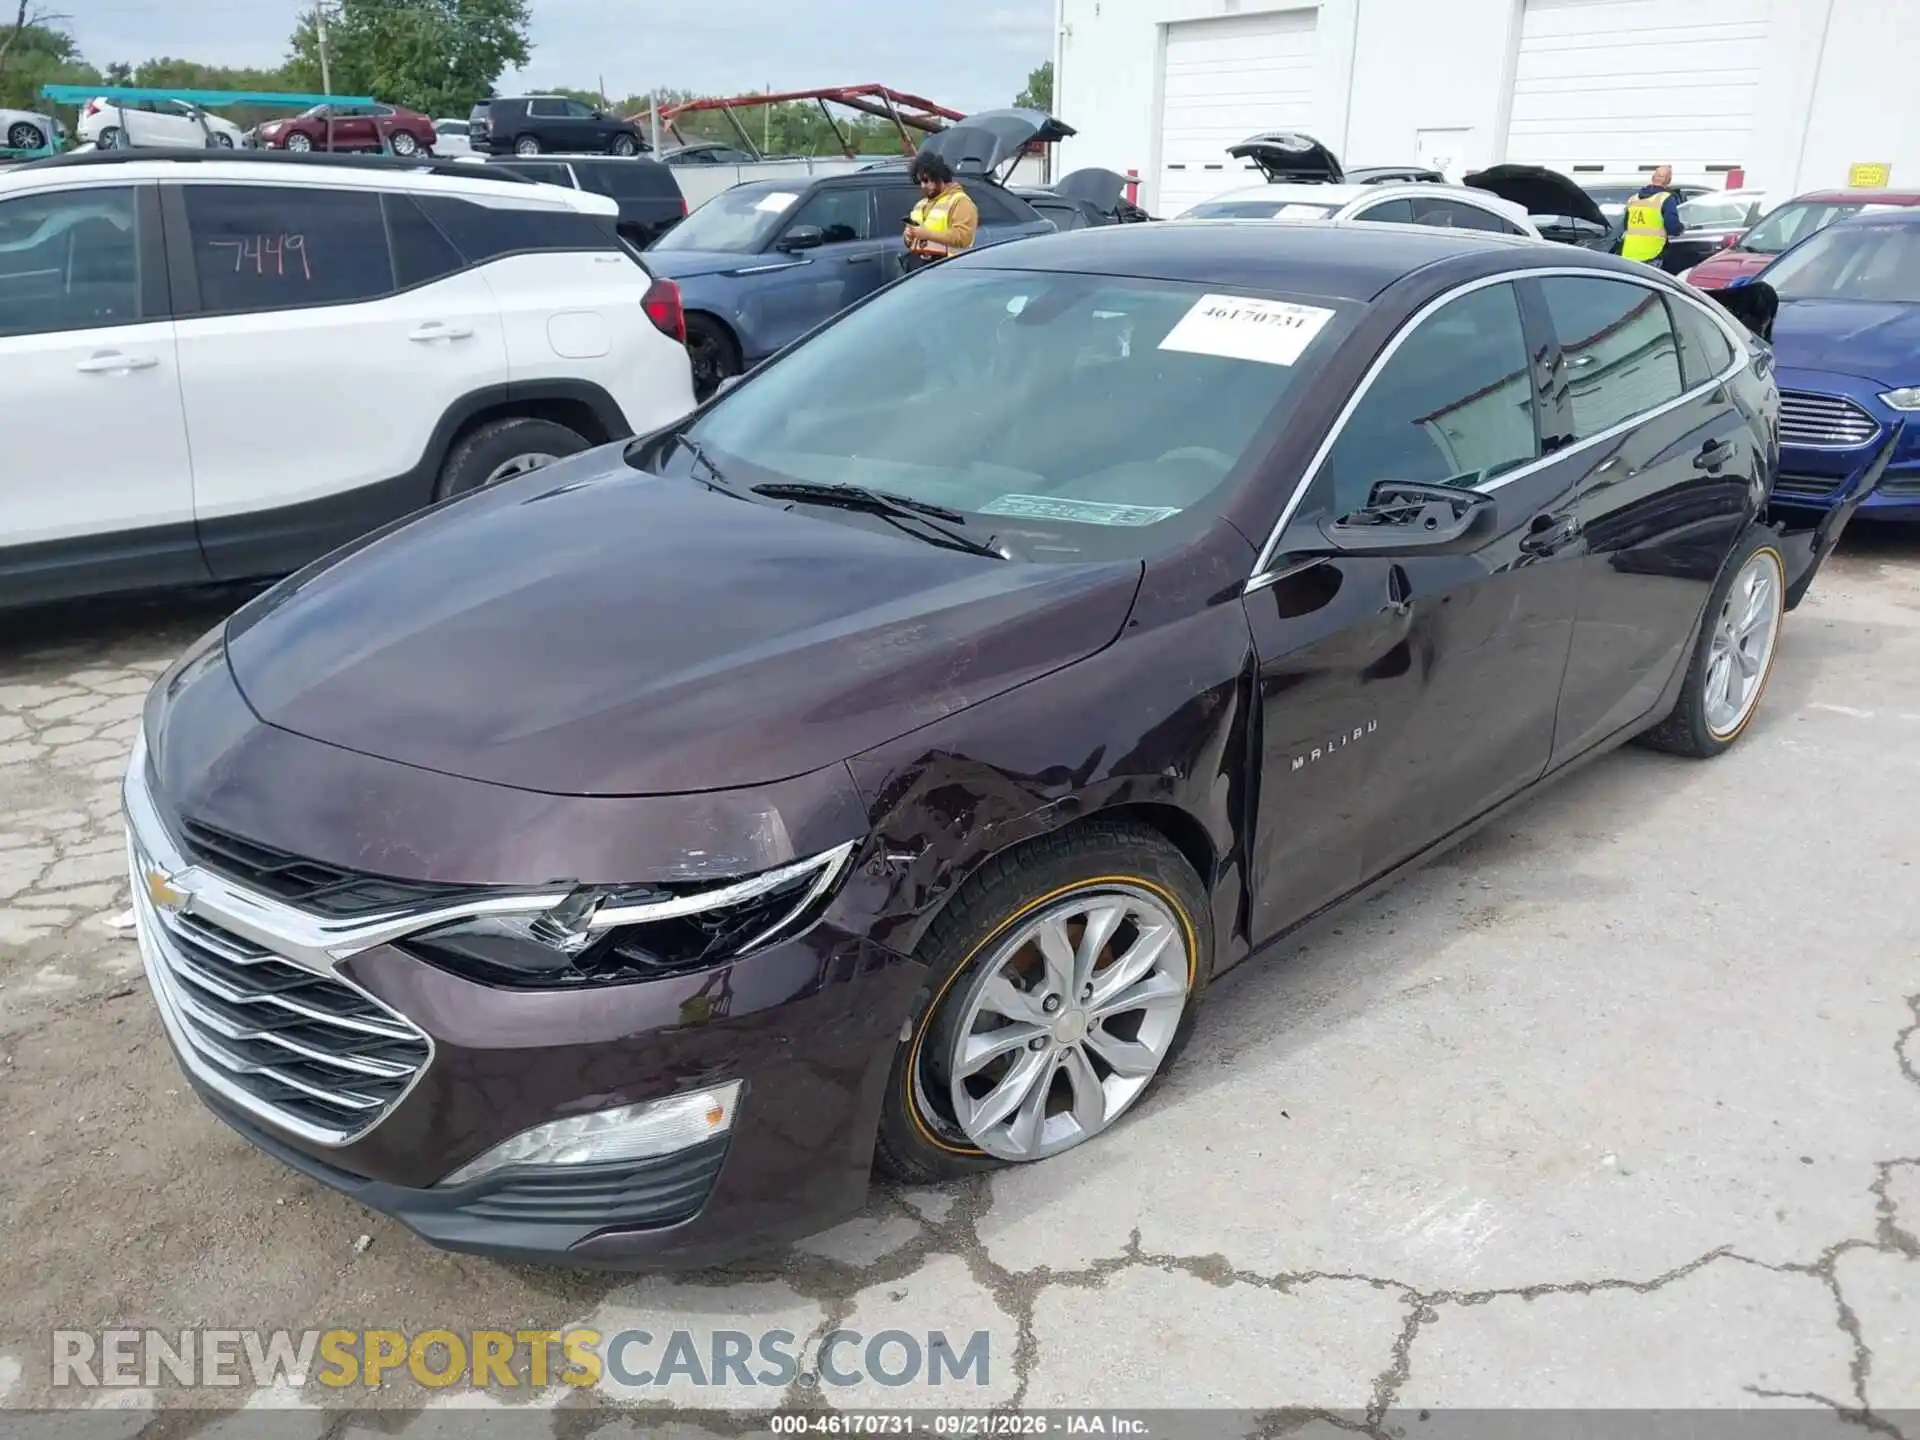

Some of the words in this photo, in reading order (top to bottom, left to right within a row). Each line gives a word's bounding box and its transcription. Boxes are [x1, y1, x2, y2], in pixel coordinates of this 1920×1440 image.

[208, 232, 311, 280] 7449
[1202, 306, 1306, 329] 46170731
[1291, 719, 1378, 772] MALIBU
